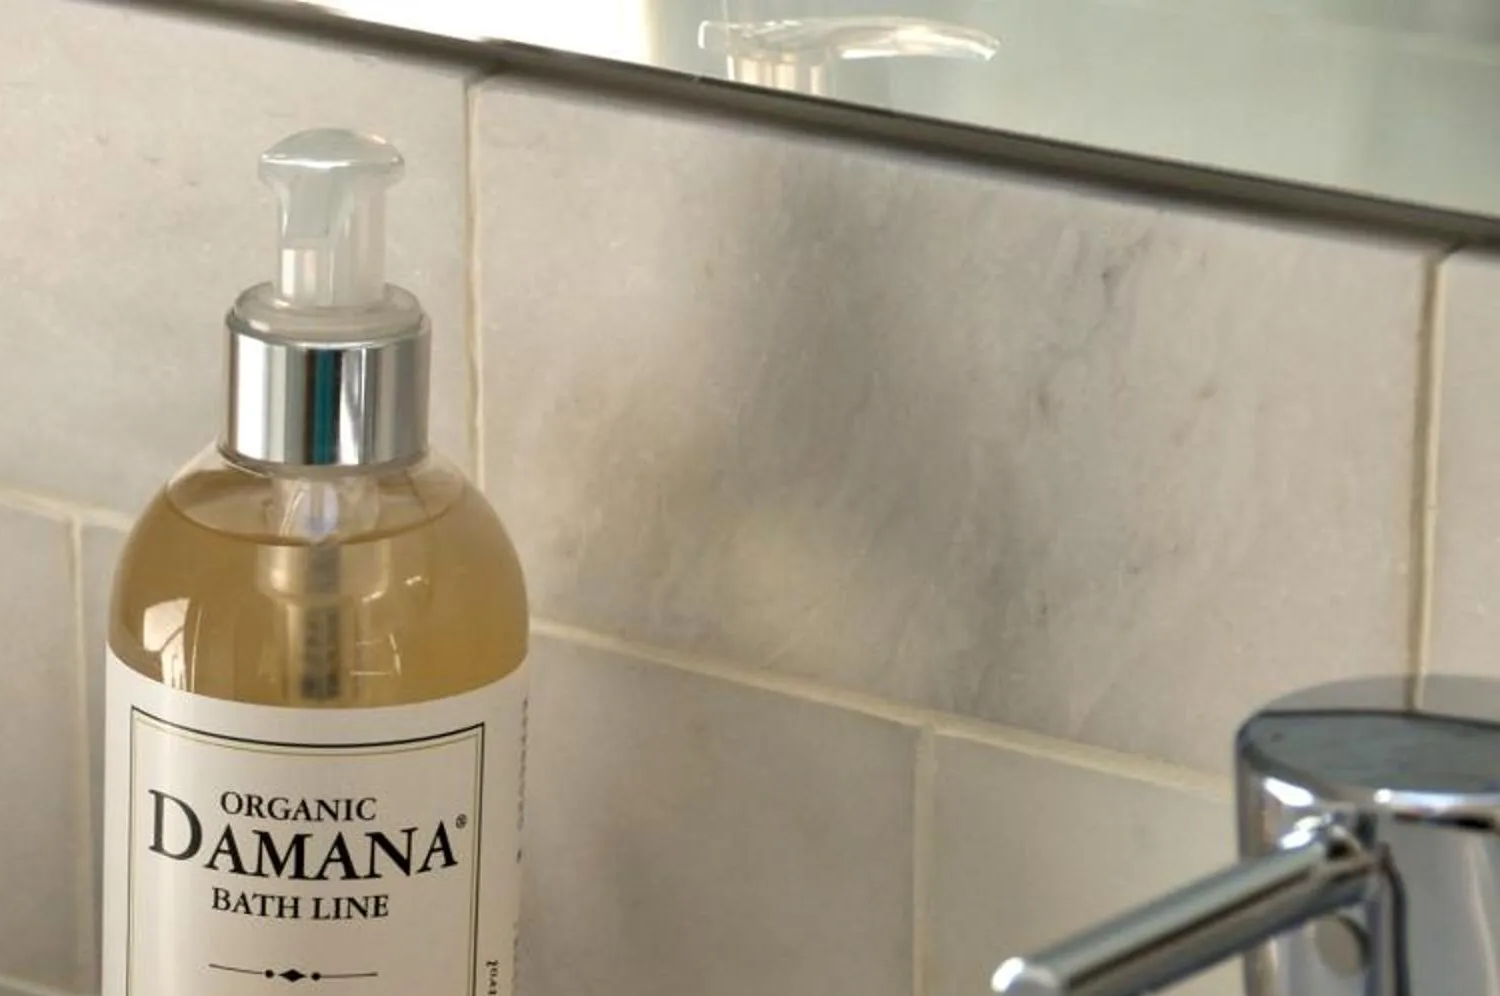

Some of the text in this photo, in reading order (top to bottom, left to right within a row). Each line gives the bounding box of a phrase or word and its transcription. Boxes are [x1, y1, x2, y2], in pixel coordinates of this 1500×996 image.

[220, 789, 377, 822] ORGANIC
[211, 886, 390, 921] BATH LINE
